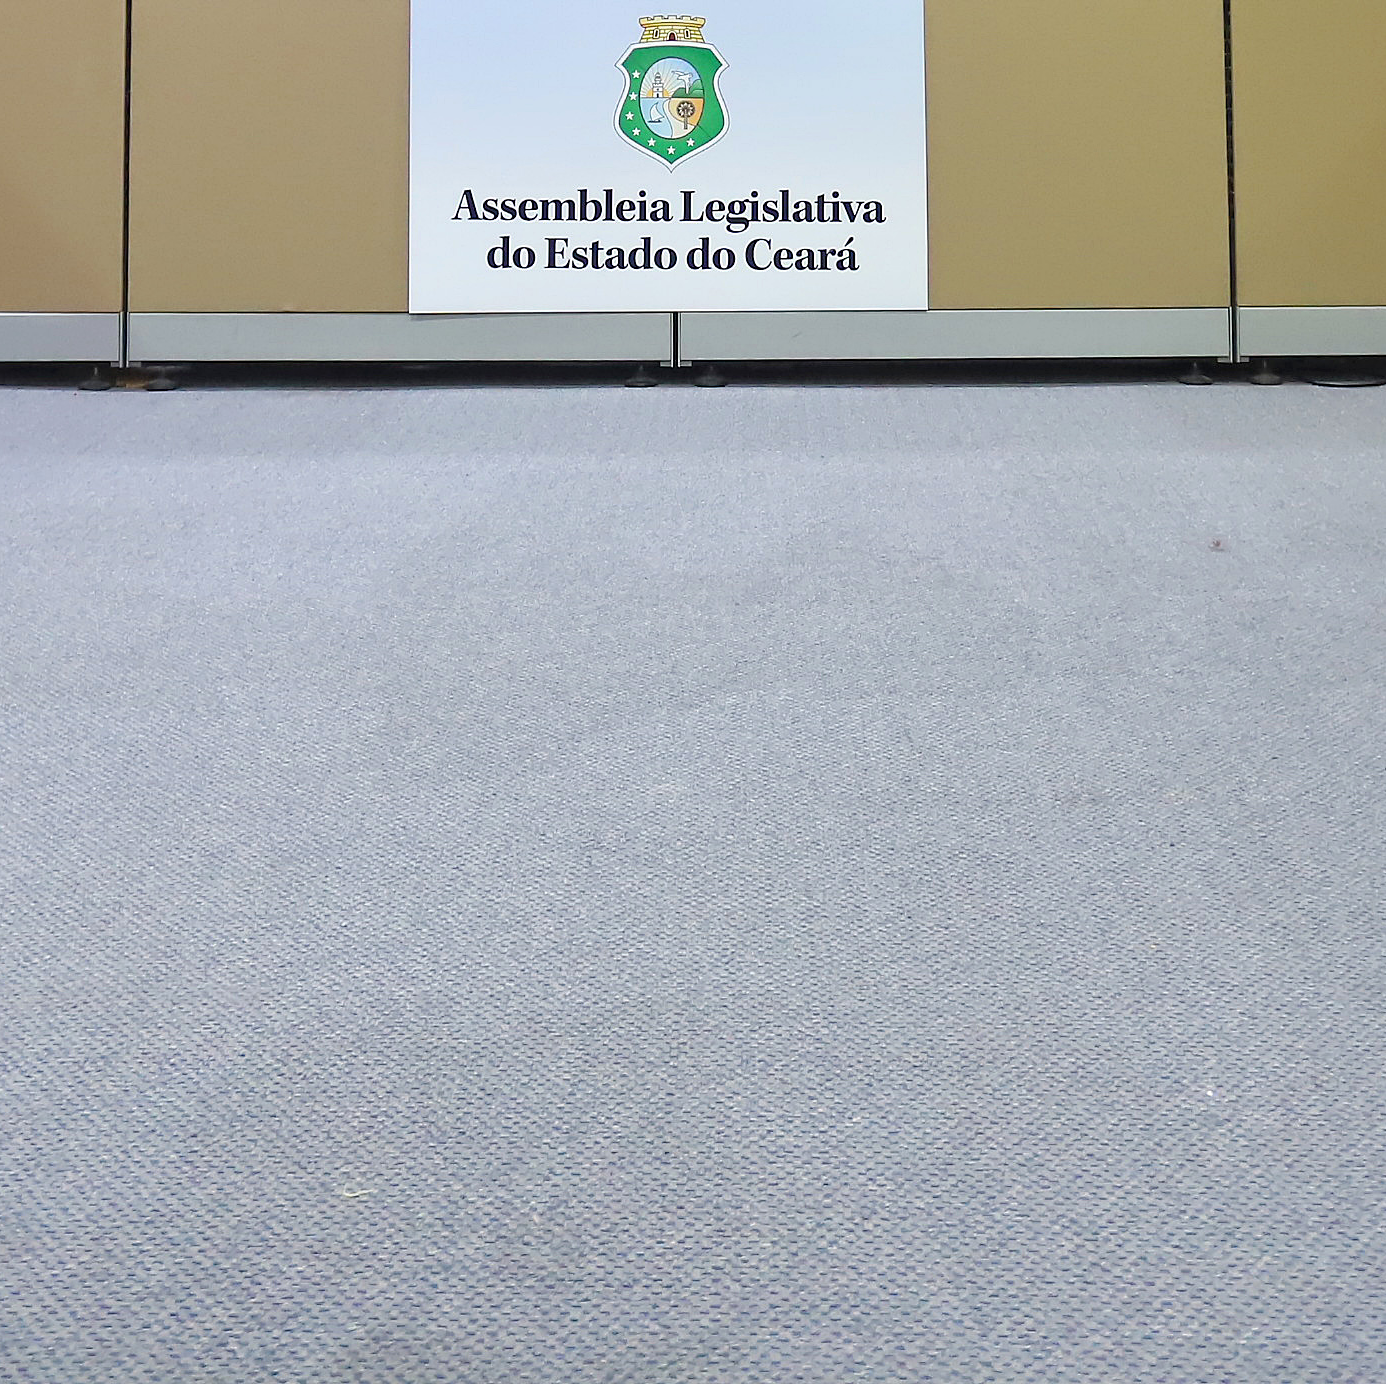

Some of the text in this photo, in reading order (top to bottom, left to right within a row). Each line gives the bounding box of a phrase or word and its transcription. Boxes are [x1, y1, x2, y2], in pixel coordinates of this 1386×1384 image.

[450, 189, 887, 234] Assembleia Legislativa
[486, 236, 860, 271] do Estado do Ceará
